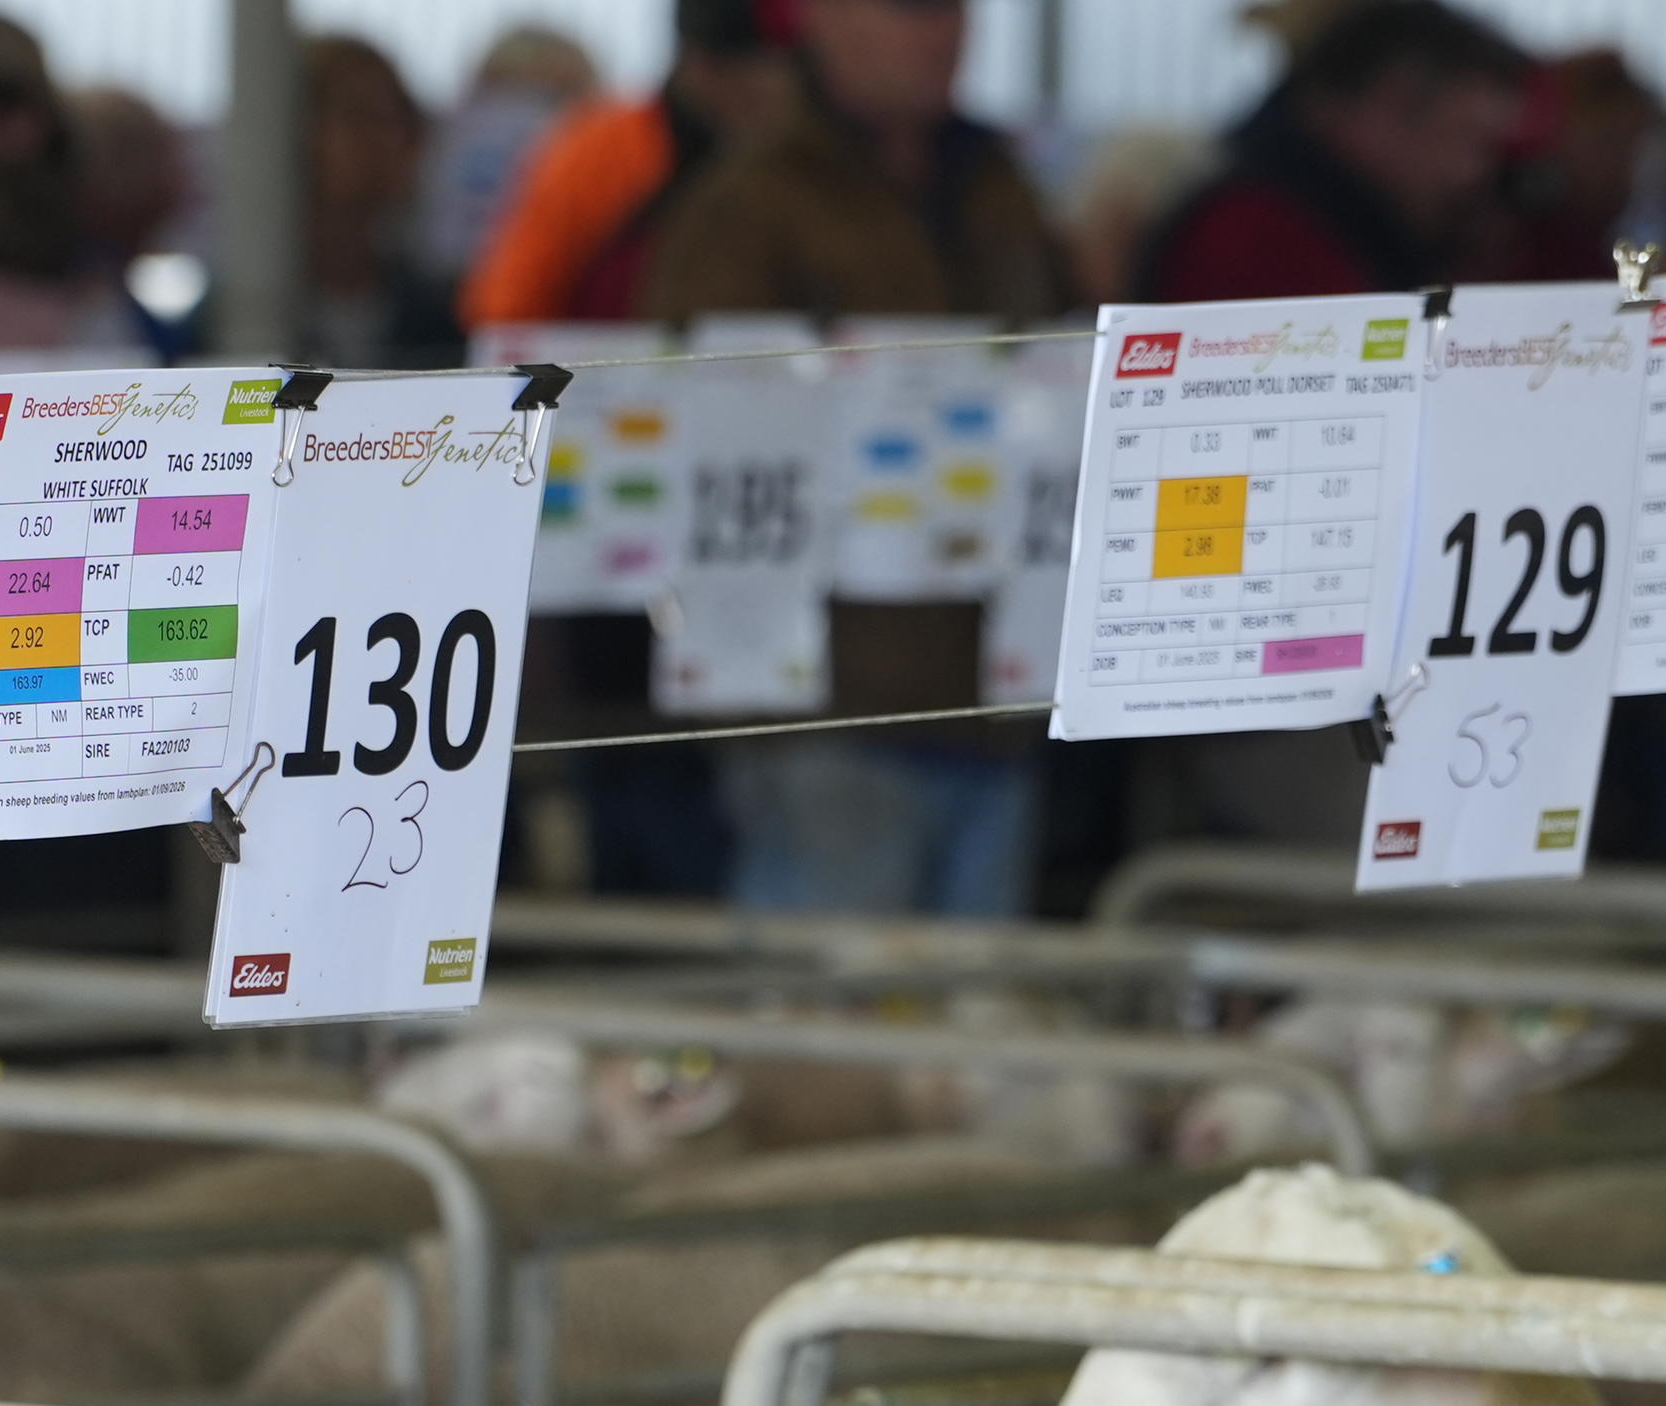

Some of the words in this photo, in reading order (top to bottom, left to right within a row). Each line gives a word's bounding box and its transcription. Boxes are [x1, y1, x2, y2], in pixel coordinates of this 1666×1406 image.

[239, 407, 271, 418] Livestock
[54, 440, 148, 464] SHERWOOD
[167, 453, 194, 473] TAG
[201, 451, 253, 472] 251099
[43, 480, 86, 500] WHITE
[90, 478, 149, 498] SUFFOLK
[93, 507, 126, 524] WWT
[172, 509, 213, 531] 14.54
[19, 516, 53, 538] 0.50
[87, 563, 120, 581] PFAT
[166, 565, 204, 588] -0.42
[1428, 504, 1606, 659] 129
[8, 572, 52, 594] 22.64
[10, 627, 45, 649] 2.92
[84, 619, 110, 637] TCP
[157, 618, 209, 642] 163.62
[11, 675, 44, 690] 163.97
[84, 672, 115, 686] FWEC
[168, 667, 199, 682] -35.00
[282, 609, 497, 778] 130
[51, 710, 68, 724] NM
[85, 707, 114, 721] REAR
[116, 705, 145, 720] TYPE
[191, 704, 197, 716] 2
[19, 745, 35, 756] June
[85, 744, 111, 759] SIRE
[141, 738, 191, 757] FA220103
[1447, 701, 1533, 790] 53
[5, 796, 32, 807] sheep
[33, 793, 69, 807] breeding
[70, 792, 96, 803] values
[97, 790, 116, 801] from
[338, 780, 430, 892] 23
[429, 945, 474, 965] Nutrien
[233, 962, 285, 989] Elders
